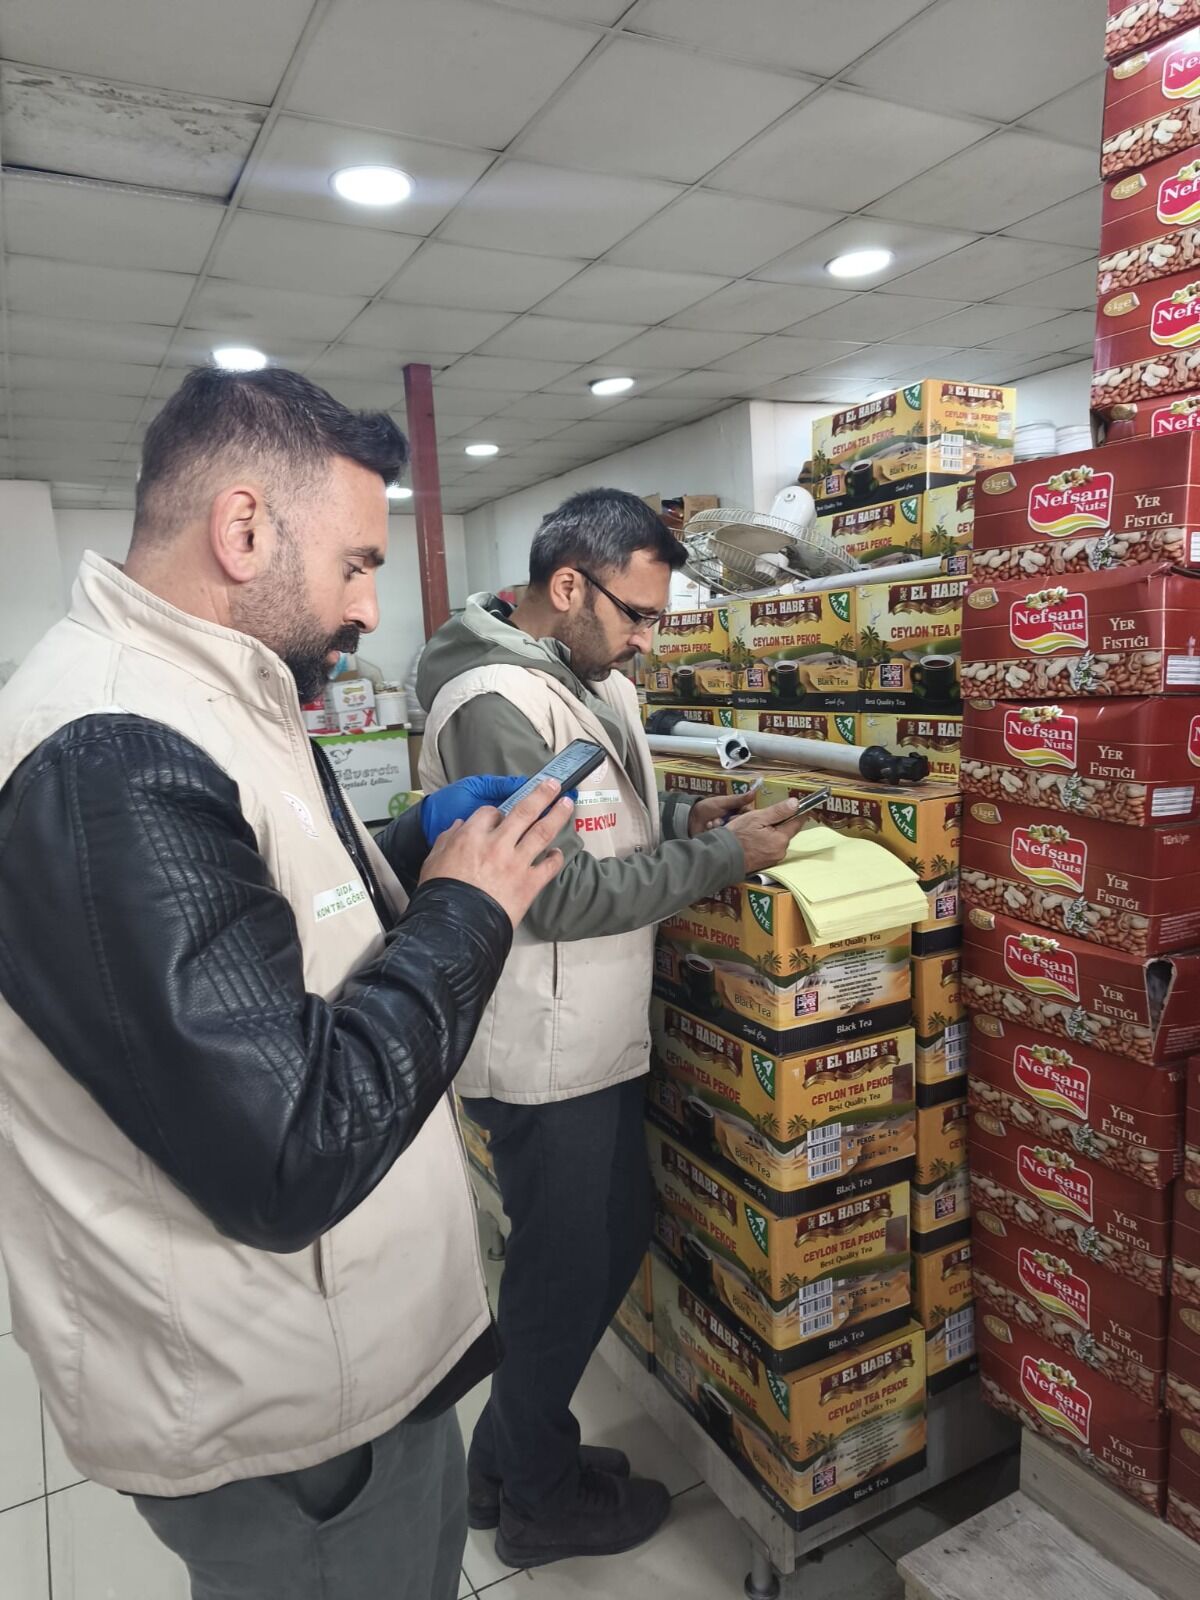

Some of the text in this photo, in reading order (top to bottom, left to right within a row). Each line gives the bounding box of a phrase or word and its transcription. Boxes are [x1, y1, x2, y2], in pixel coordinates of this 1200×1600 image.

[1163, 176, 1200, 203] Nef
[1157, 303, 1200, 324] Nefs
[956, 386, 990, 398] EL HABE
[846, 402, 881, 422] EL HABE
[1157, 415, 1200, 433] Nefs
[832, 428, 894, 455] CEYLON TEA PEKOE
[1034, 488, 1108, 509] Nefsan
[1074, 502, 1107, 513] Nuts
[1134, 495, 1161, 509] YER
[846, 508, 881, 526] EL HABE
[1125, 513, 1173, 529] FISTIĞI
[857, 540, 870, 551] TEA
[871, 537, 892, 549] PEKOE
[911, 585, 927, 599] EL
[766, 600, 805, 615] EL HABE
[1015, 608, 1084, 626] Nefsan
[671, 613, 703, 626] EL HABE
[1052, 621, 1084, 632] Nuts
[1109, 618, 1135, 630] YER
[753, 634, 821, 648] CEYLON TEA PEKOE
[891, 626, 929, 638] CEYLON
[931, 625, 951, 636] TEA
[659, 643, 711, 653] CEYLON TEA PEKOE
[1103, 635, 1149, 650] FISTIĞI
[818, 677, 832, 685] Black
[876, 698, 894, 707] Quality
[773, 715, 811, 728] EL HABE
[918, 722, 934, 736] EL
[1008, 721, 1073, 740] Nefsan
[1043, 738, 1073, 751] Nuts
[1097, 746, 1123, 761] YER
[935, 763, 956, 773] TEA
[1090, 763, 1135, 778] FISTIĞI
[678, 777, 712, 792] EL HABE
[826, 797, 860, 815] HABE
[890, 804, 914, 838] KALİTE
[1016, 838, 1082, 865] Nefsan
[1052, 859, 1081, 874] Nuts
[1106, 874, 1129, 891] YER
[1096, 888, 1139, 911] FISTIĞI
[692, 921, 740, 950] TEA PEKOE
[844, 935, 864, 948] Quality
[865, 932, 881, 941] Tea
[1008, 946, 1074, 975] Nefsan
[1044, 969, 1075, 985] Nuts
[1099, 984, 1124, 1002] YER
[735, 994, 772, 1018] Black Tea
[1093, 999, 1138, 1020] FISTIĞI
[680, 1018, 724, 1052] EL HABE
[837, 1019, 873, 1034] Black Tea
[826, 1046, 877, 1069] EL HABE
[1019, 1056, 1085, 1091] Nefsan
[694, 1068, 711, 1088] TEA
[713, 1079, 741, 1104] PEKOE
[812, 1075, 894, 1106] CEYLON TEA PEKOE
[1054, 1083, 1085, 1103] Nuts
[828, 1092, 880, 1113] Best Quality Tea
[1110, 1105, 1135, 1125] YER
[1101, 1118, 1147, 1146] FISTIĞI
[735, 1148, 771, 1179] Black Tea
[676, 1156, 719, 1198] EL HABE
[836, 1177, 872, 1195] Black Tea
[1021, 1156, 1088, 1196] Nefsan
[1057, 1186, 1089, 1205] Nuts
[818, 1199, 870, 1227] EL HABE
[1113, 1209, 1138, 1231] YER
[692, 1203, 708, 1225] TEA
[709, 1218, 736, 1251] PEKOE
[1106, 1222, 1151, 1252] FISTIĞI
[803, 1228, 886, 1264] CEYLON TEA PEKOE
[820, 1248, 872, 1269] Best Quality Tea
[1022, 1258, 1086, 1303] Nefsan
[1057, 1290, 1085, 1312] Nuts
[694, 1301, 740, 1355] EL HABE
[1109, 1320, 1132, 1342] YER
[828, 1329, 864, 1350] Black Tea
[1102, 1331, 1143, 1363] FISTIĞI
[842, 1351, 892, 1384] EL HABE
[728, 1378, 758, 1412] PEKOE
[828, 1378, 909, 1422] CEYLON TEA PEKOE
[1025, 1366, 1087, 1418] Nefsan
[846, 1398, 897, 1424] Best Quality Tea
[1057, 1402, 1086, 1425] Nuts
[1102, 1447, 1146, 1478] FISTIĞI
[854, 1477, 889, 1500] Black Tea
